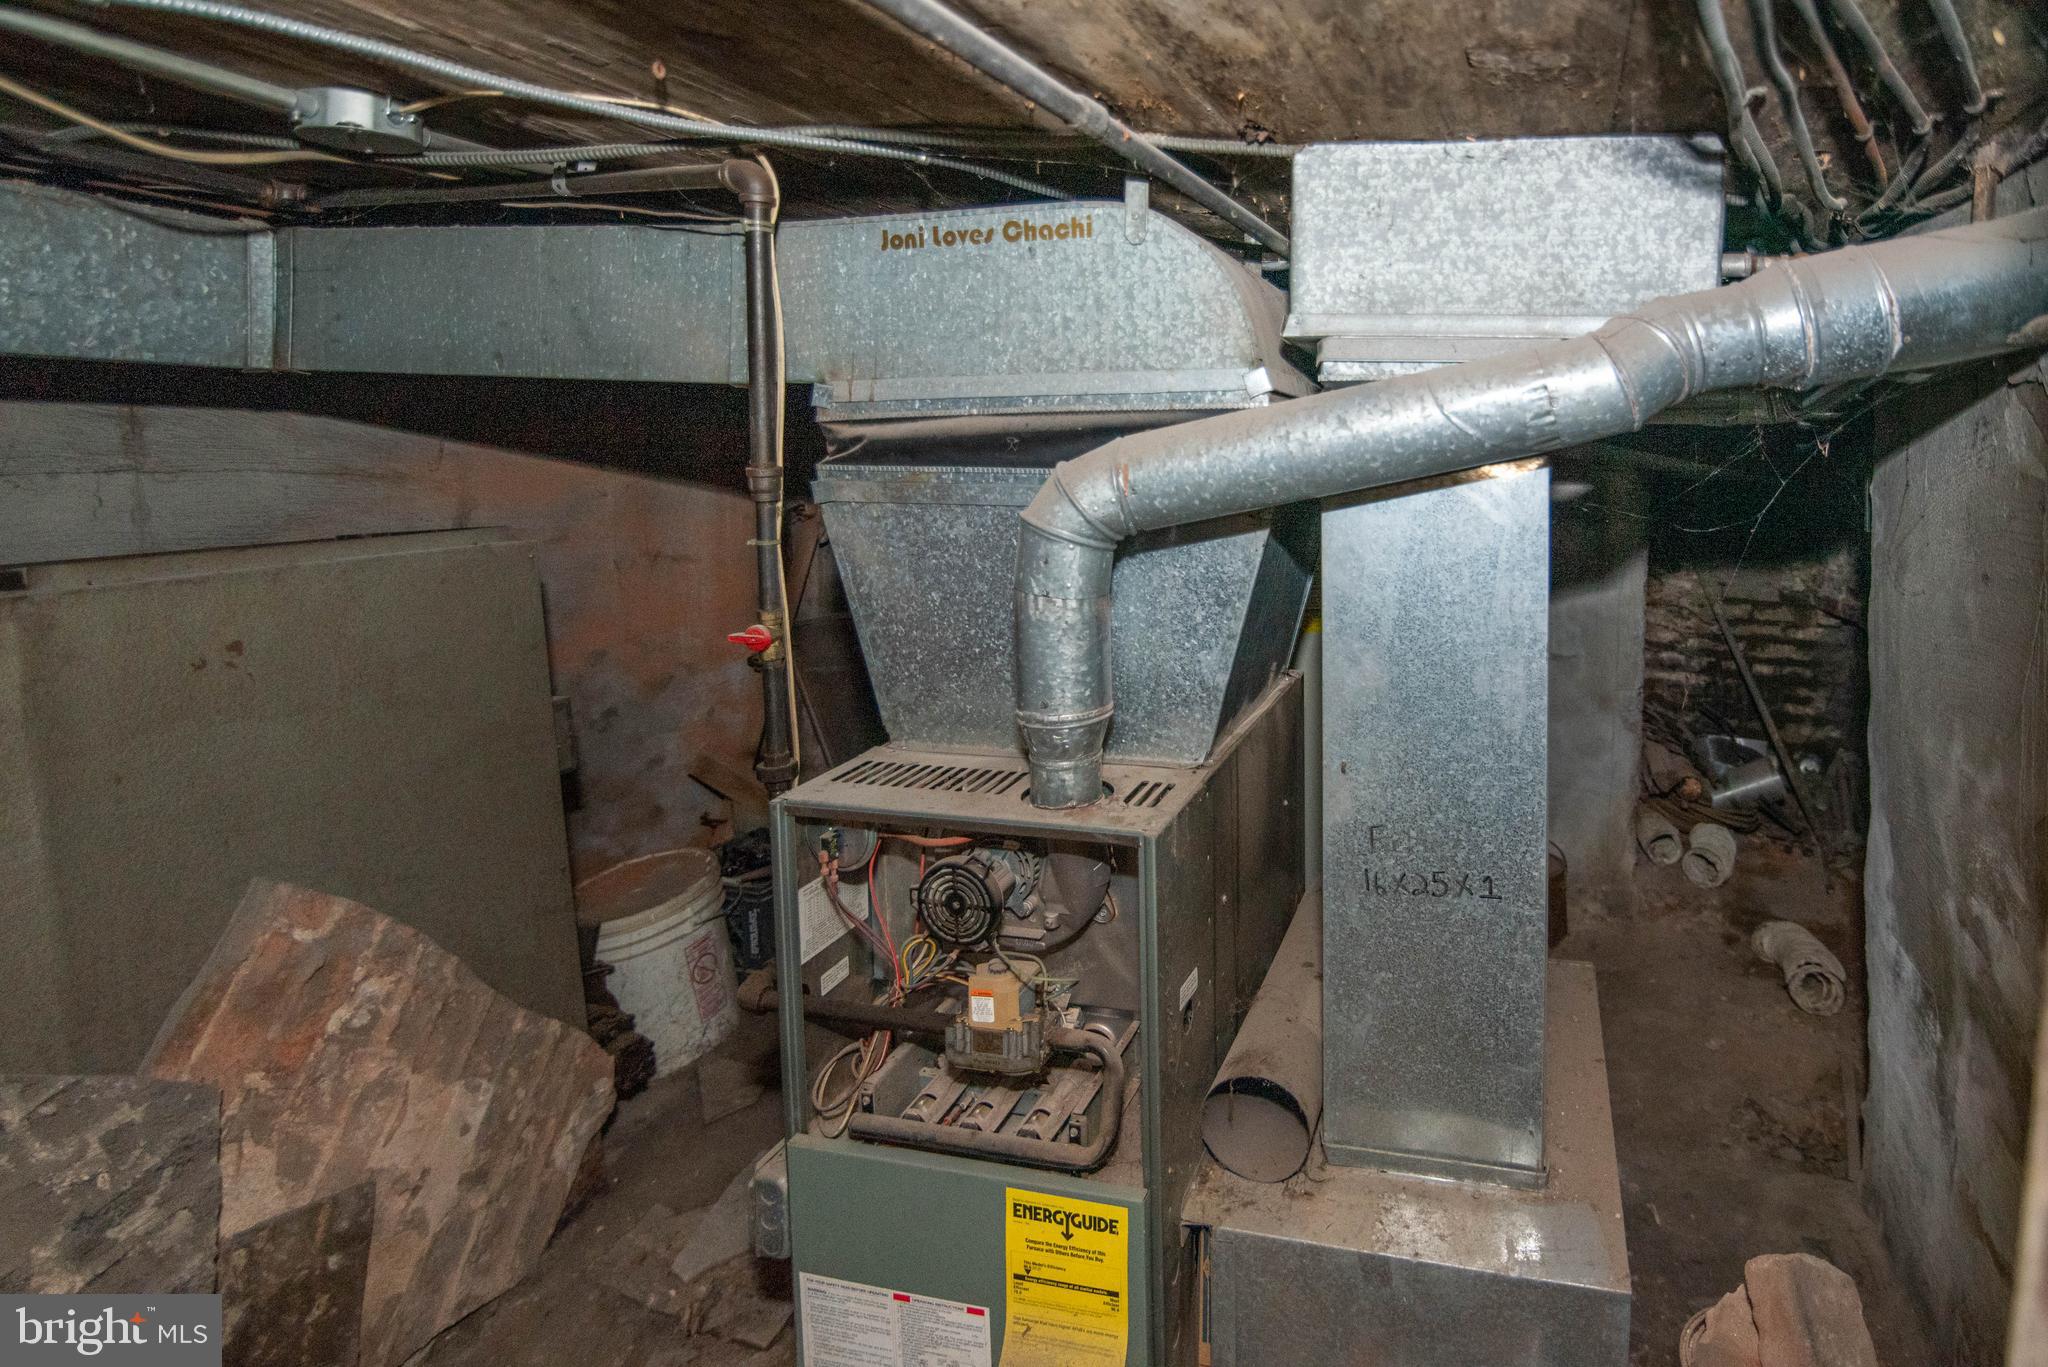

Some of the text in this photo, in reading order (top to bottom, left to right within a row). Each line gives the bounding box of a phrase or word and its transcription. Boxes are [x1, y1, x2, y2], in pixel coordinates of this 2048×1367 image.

[881, 214, 1093, 251] Joni Loves Chachi
[1053, 1242, 1067, 1250] Energy
[1068, 1245, 1090, 1254] Efficiency
